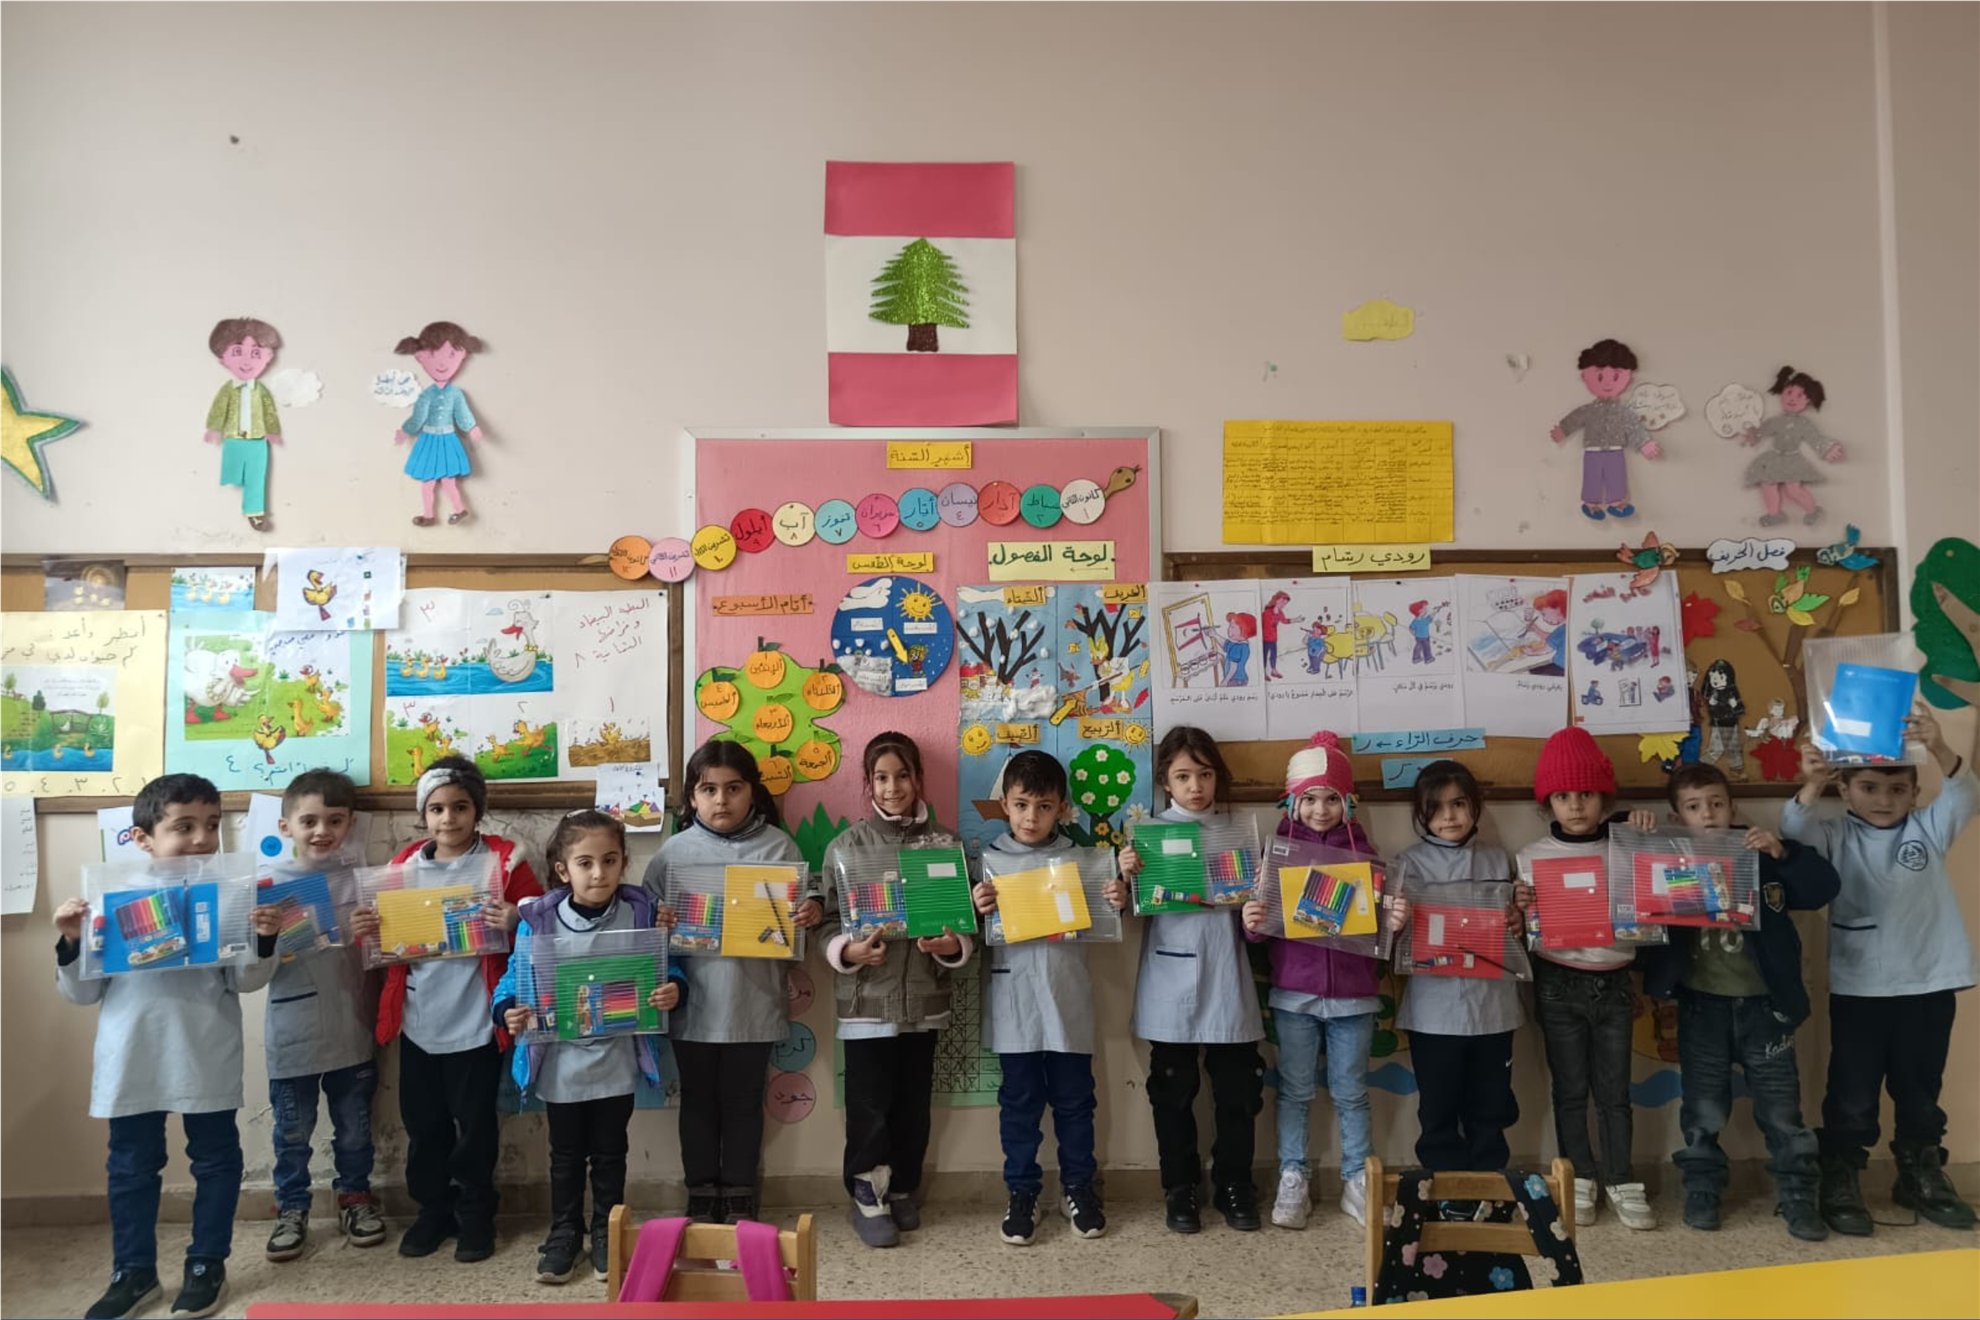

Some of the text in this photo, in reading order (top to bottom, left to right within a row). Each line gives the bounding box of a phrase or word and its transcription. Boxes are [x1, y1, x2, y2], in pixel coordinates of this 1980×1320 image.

[931, 444, 970, 465] أشهر
[941, 491, 978, 507] نيسان
[779, 512, 809, 531] آب
[956, 511, 963, 520] ٤
[736, 516, 768, 540] أيلول
[790, 532, 798, 540] ٨
[835, 528, 843, 537] ٧
[873, 524, 881, 532] ٦
[992, 543, 1107, 566] لوحة الفصول
[1370, 551, 1425, 566] رودي
[1756, 543, 1786, 562] فصل
[897, 553, 927, 570] لوحة
[419, 600, 435, 622] ٣
[717, 595, 777, 614] الأسبوع
[20, 642, 36, 661] في
[122, 645, 138, 668] كم
[575, 652, 585, 669] ٨
[403, 701, 416, 717] ٣
[517, 701, 528, 713] ٢
[609, 697, 615, 712] ١
[1433, 733, 1478, 748] حرف
[226, 755, 241, 772] ٤
